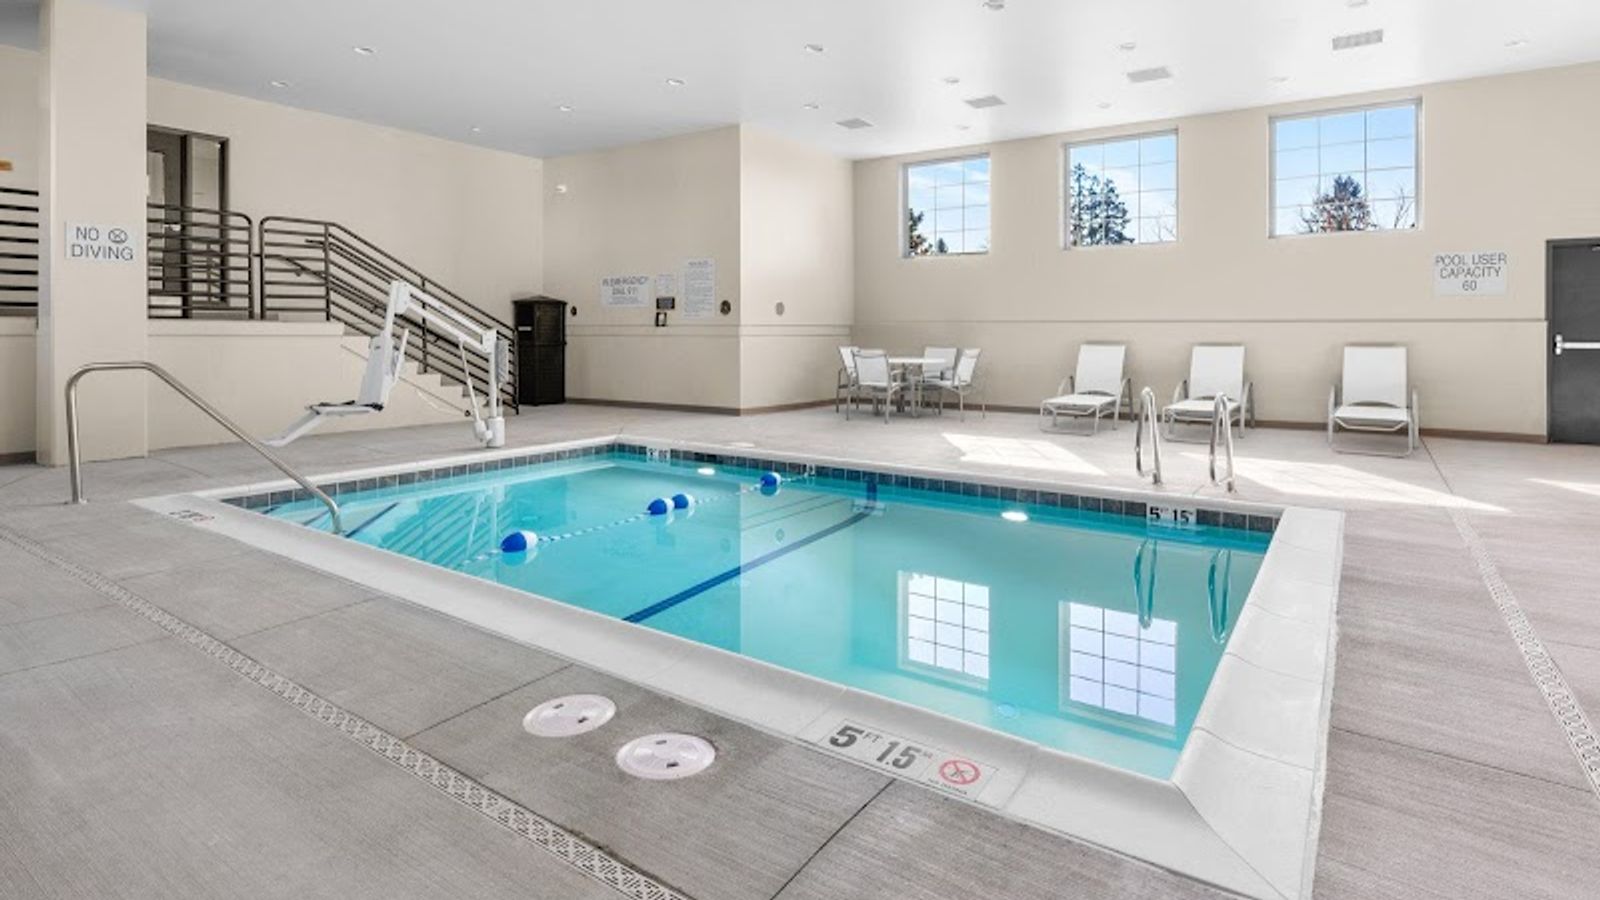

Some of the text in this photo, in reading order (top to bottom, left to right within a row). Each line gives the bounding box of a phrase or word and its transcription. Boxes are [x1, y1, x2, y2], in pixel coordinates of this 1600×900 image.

[76, 226, 99, 241] NO
[71, 243, 133, 261] DIVING
[1435, 252, 1507, 267] POOL USER
[1440, 265, 1502, 279] CAPACITY
[1462, 280, 1477, 291] 60
[1150, 506, 1160, 521] 5
[829, 725, 865, 748] 5
[862, 731, 883, 743] FT
[876, 740, 922, 769] 1.5
